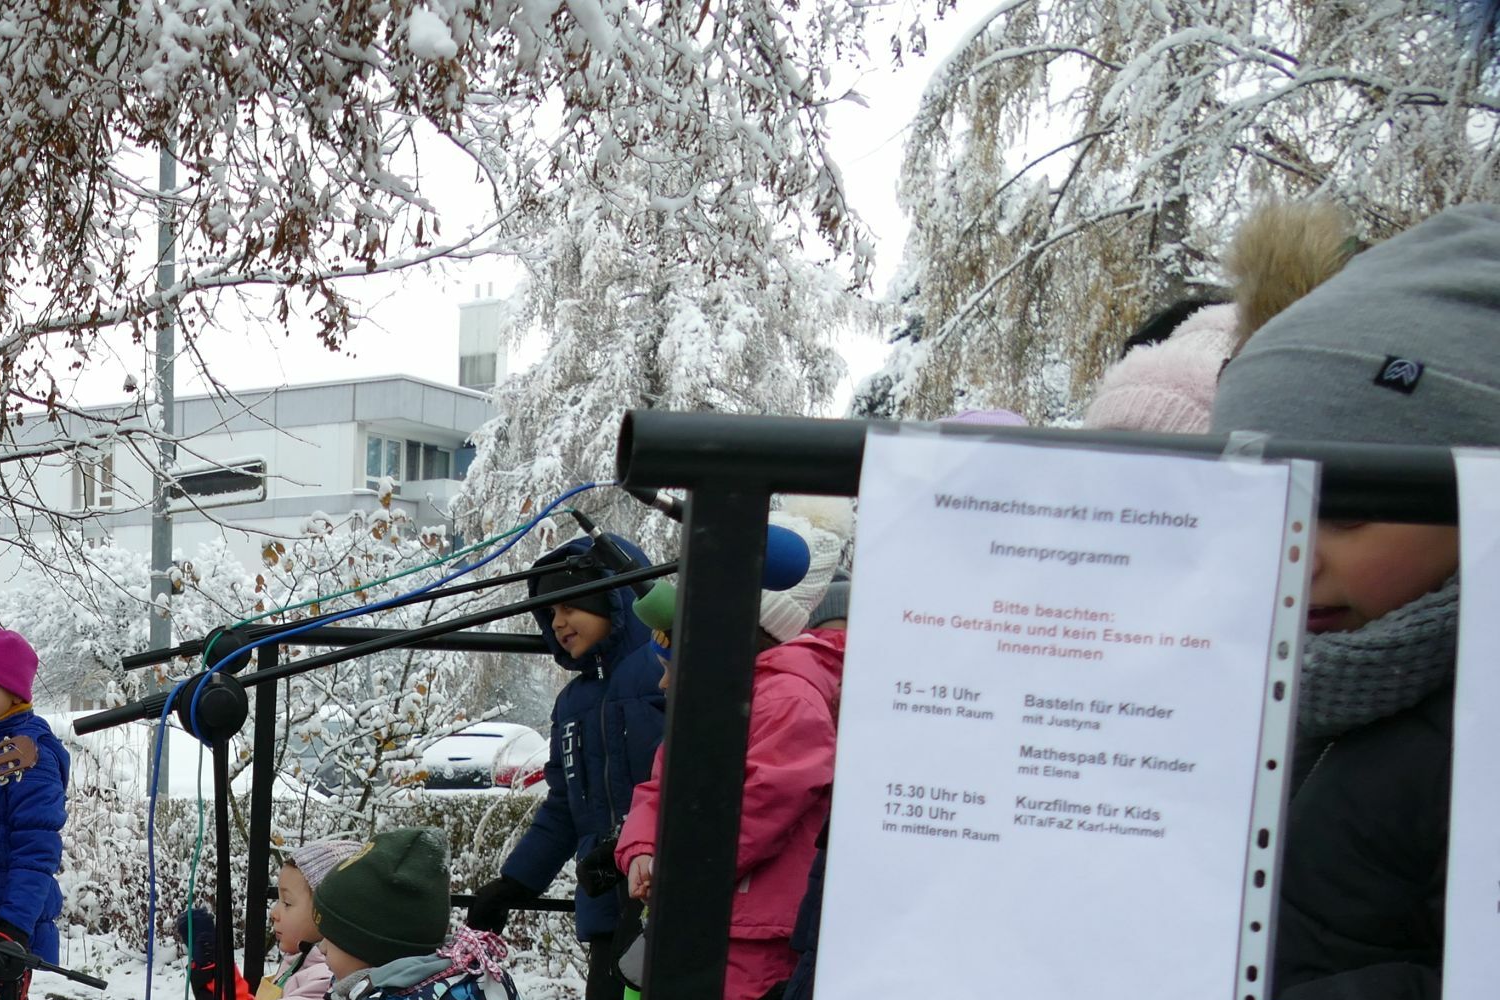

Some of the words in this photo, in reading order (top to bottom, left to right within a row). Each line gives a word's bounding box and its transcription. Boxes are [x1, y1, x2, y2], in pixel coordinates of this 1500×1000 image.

[934, 494, 1088, 520] Weihnachtsmarkt
[1092, 508, 1114, 523] im
[1119, 509, 1199, 529] Eichholz
[989, 541, 1131, 566] Innenprogramm
[992, 600, 1029, 616] Bitte
[1034, 603, 1116, 623] beachten:
[902, 610, 946, 627] Keine
[950, 615, 1022, 634] Getränke
[1026, 623, 1057, 638] und
[1062, 626, 1097, 641] kein
[1102, 629, 1153, 645] Essen
[1159, 633, 1175, 646] in
[1179, 635, 1212, 649] den
[996, 640, 1104, 661] Innenräumen
[895, 681, 912, 695] 15
[930, 684, 948, 699] 18
[952, 687, 981, 702] Uhr
[892, 699, 908, 711] im
[911, 704, 952, 717] ersten
[955, 705, 994, 720] Raum
[1023, 693, 1084, 713] Basteln
[1089, 700, 1114, 714] für
[1118, 702, 1174, 720] Kinder
[1022, 714, 1044, 726] mit
[1047, 716, 1100, 731] Justyna
[562, 721, 575, 784] TECH
[1019, 744, 1107, 766] Mathespaß
[1112, 753, 1137, 768] für
[1140, 756, 1197, 773] Kinder
[1018, 765, 1039, 776] mit
[1042, 765, 1080, 780] Elena
[885, 782, 925, 799] 15.30
[930, 786, 958, 802] Uhr
[963, 790, 987, 805] bis
[884, 802, 924, 818] 17.30
[928, 806, 957, 822] Uhr
[1015, 795, 1092, 815] Kurzfilme
[1096, 803, 1119, 817] für
[1124, 805, 1161, 822] Kids
[882, 820, 897, 832] im
[901, 823, 958, 839] mittleren
[961, 827, 1000, 842] Raum
[1013, 814, 1074, 830] KiTa/FaZ
[1077, 820, 1166, 839] Karl-Hummel
